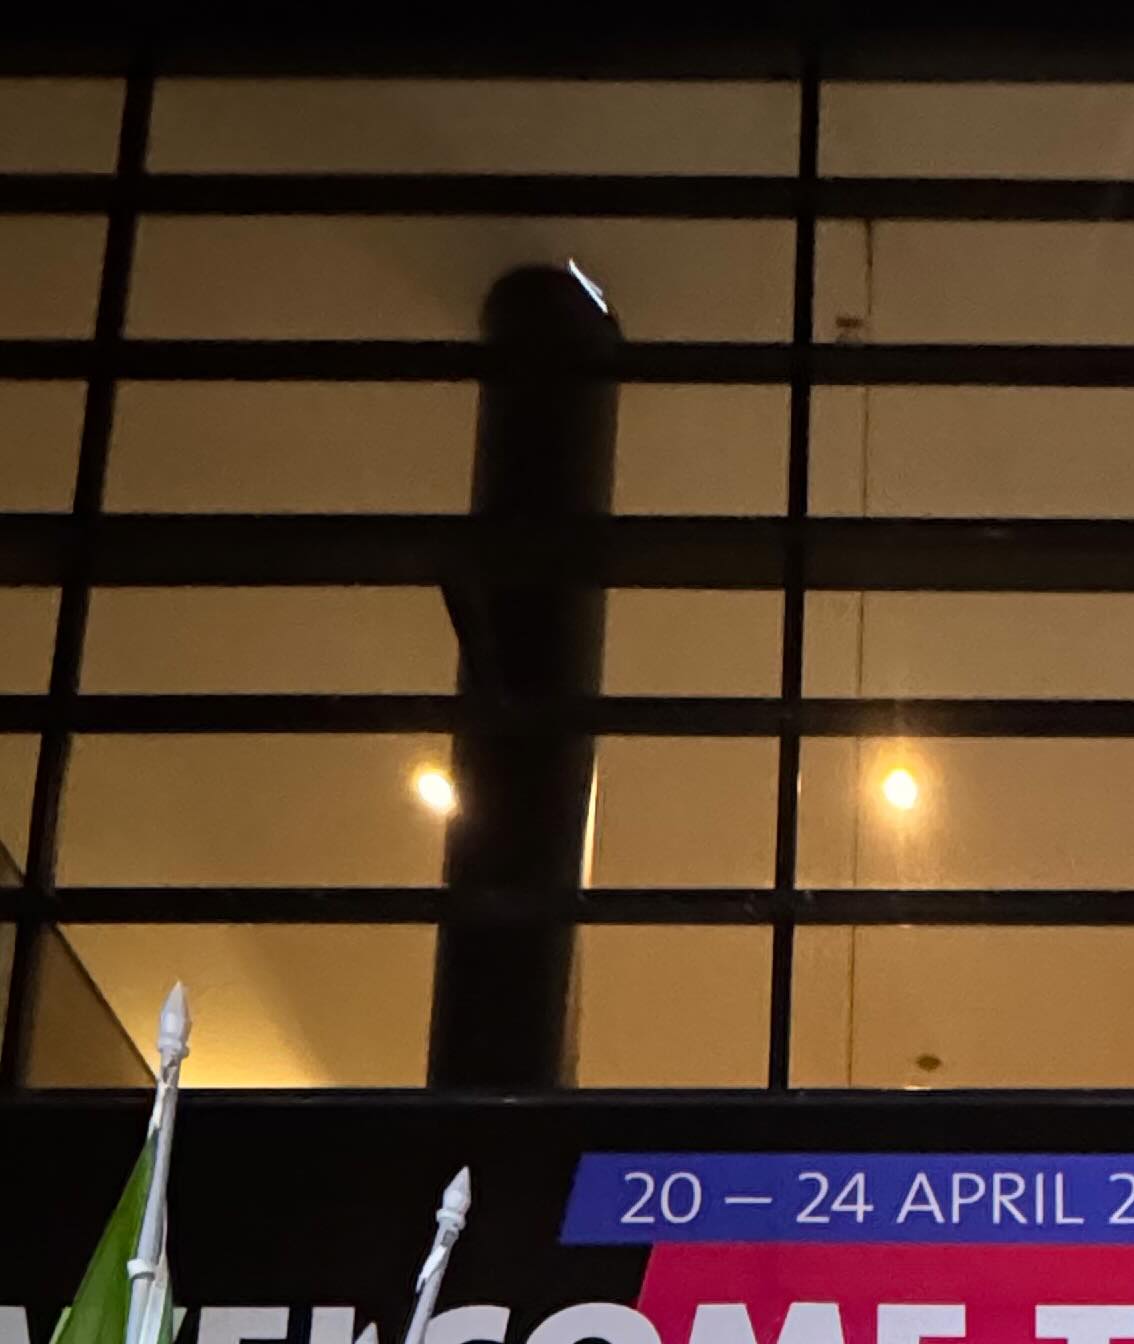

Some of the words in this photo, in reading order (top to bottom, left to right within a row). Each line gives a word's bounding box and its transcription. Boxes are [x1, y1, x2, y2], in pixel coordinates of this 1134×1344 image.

[621, 1172, 702, 1224] 20
[796, 1172, 874, 1224] 24
[896, 1172, 1084, 1224] APRIL
